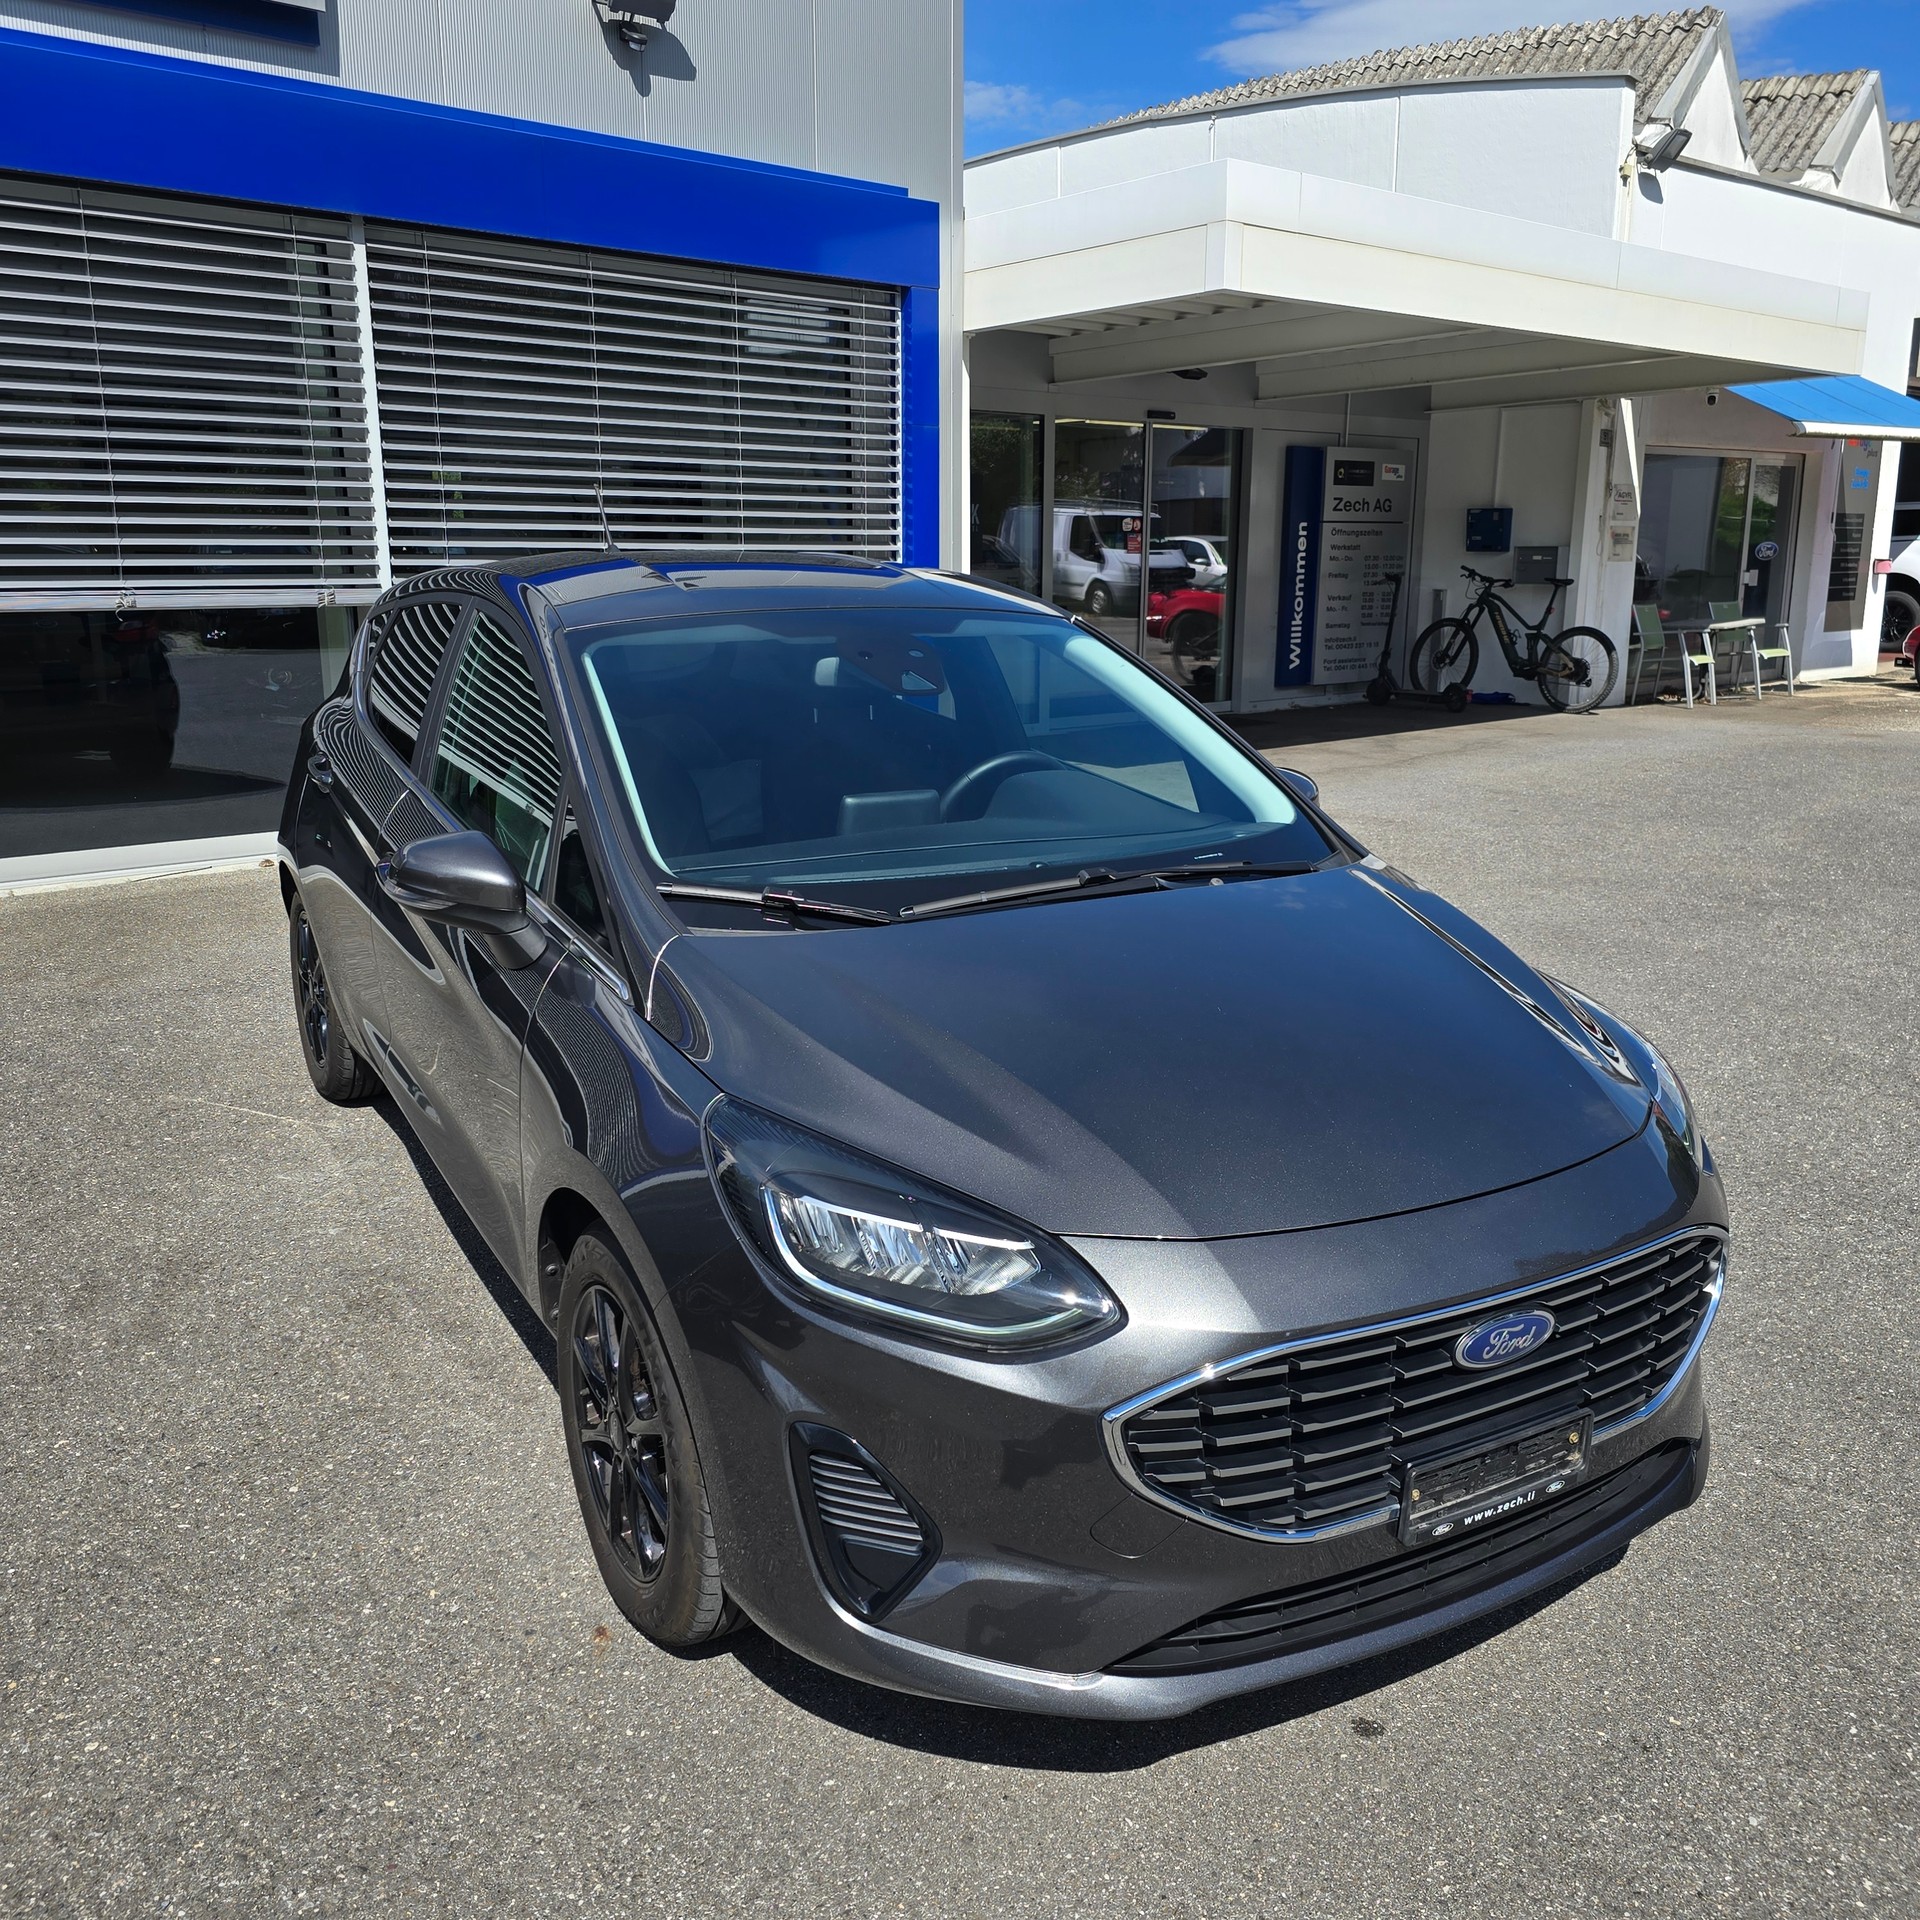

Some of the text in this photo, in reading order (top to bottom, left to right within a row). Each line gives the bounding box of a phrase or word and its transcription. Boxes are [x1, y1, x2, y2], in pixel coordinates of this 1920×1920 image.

[1332, 497, 1392, 513] Zech AG
[1331, 527, 1383, 538] Öffnungszeiten
[1328, 572, 1348, 580] Freitag
[1289, 521, 1308, 670] Willkommen
[1327, 594, 1352, 602] Verkauf
[1482, 1323, 1537, 1360] Ford
[1463, 1490, 1536, 1526] www.zech.li
